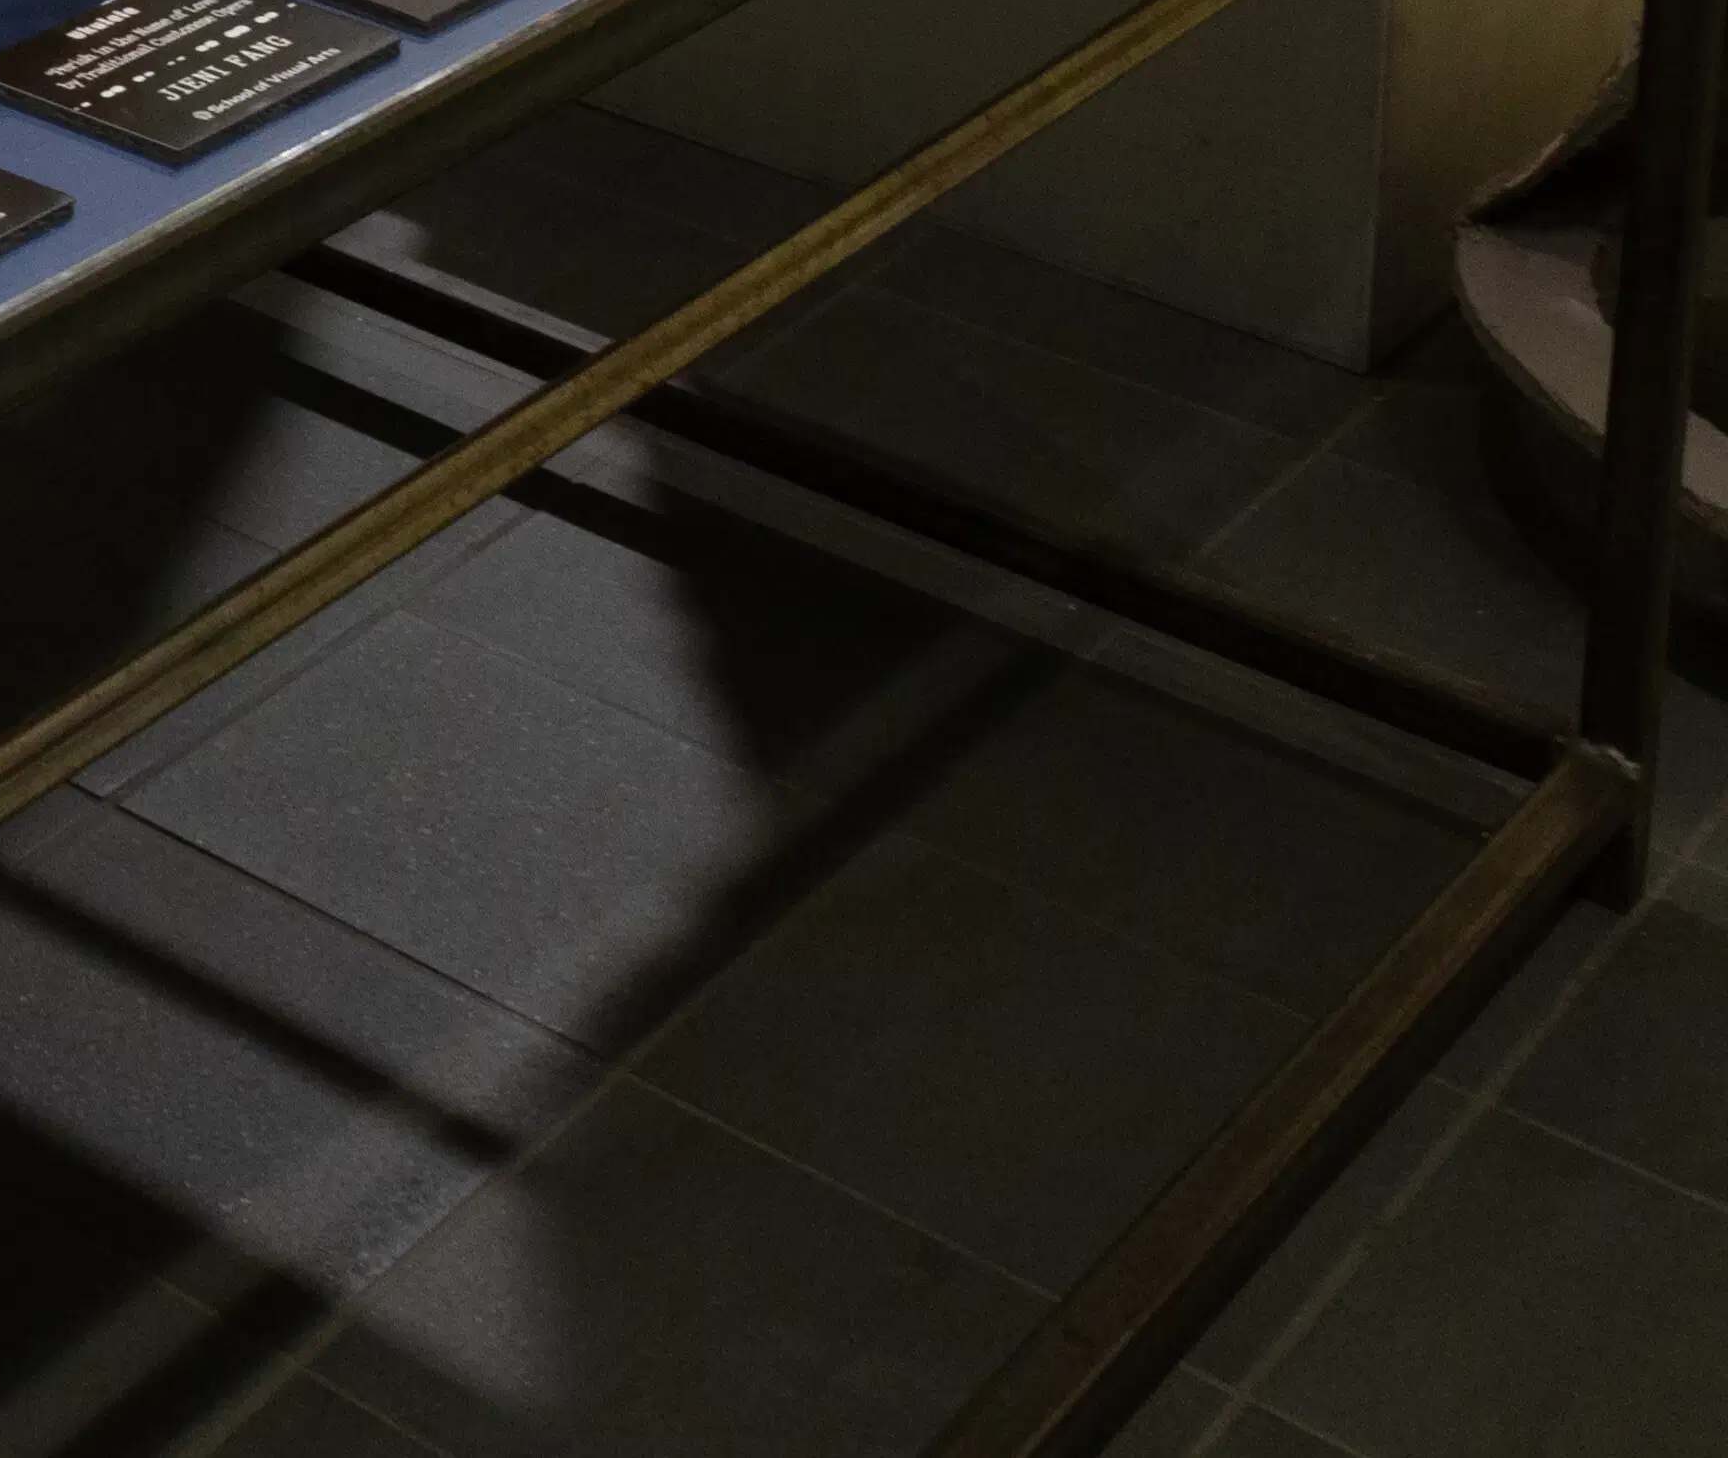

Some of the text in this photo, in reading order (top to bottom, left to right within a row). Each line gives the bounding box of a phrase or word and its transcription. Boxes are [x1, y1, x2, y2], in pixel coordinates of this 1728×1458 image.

[158, 35, 292, 101] JIENI FANG
[207, 88, 257, 113] School
[307, 48, 341, 64] Arts
